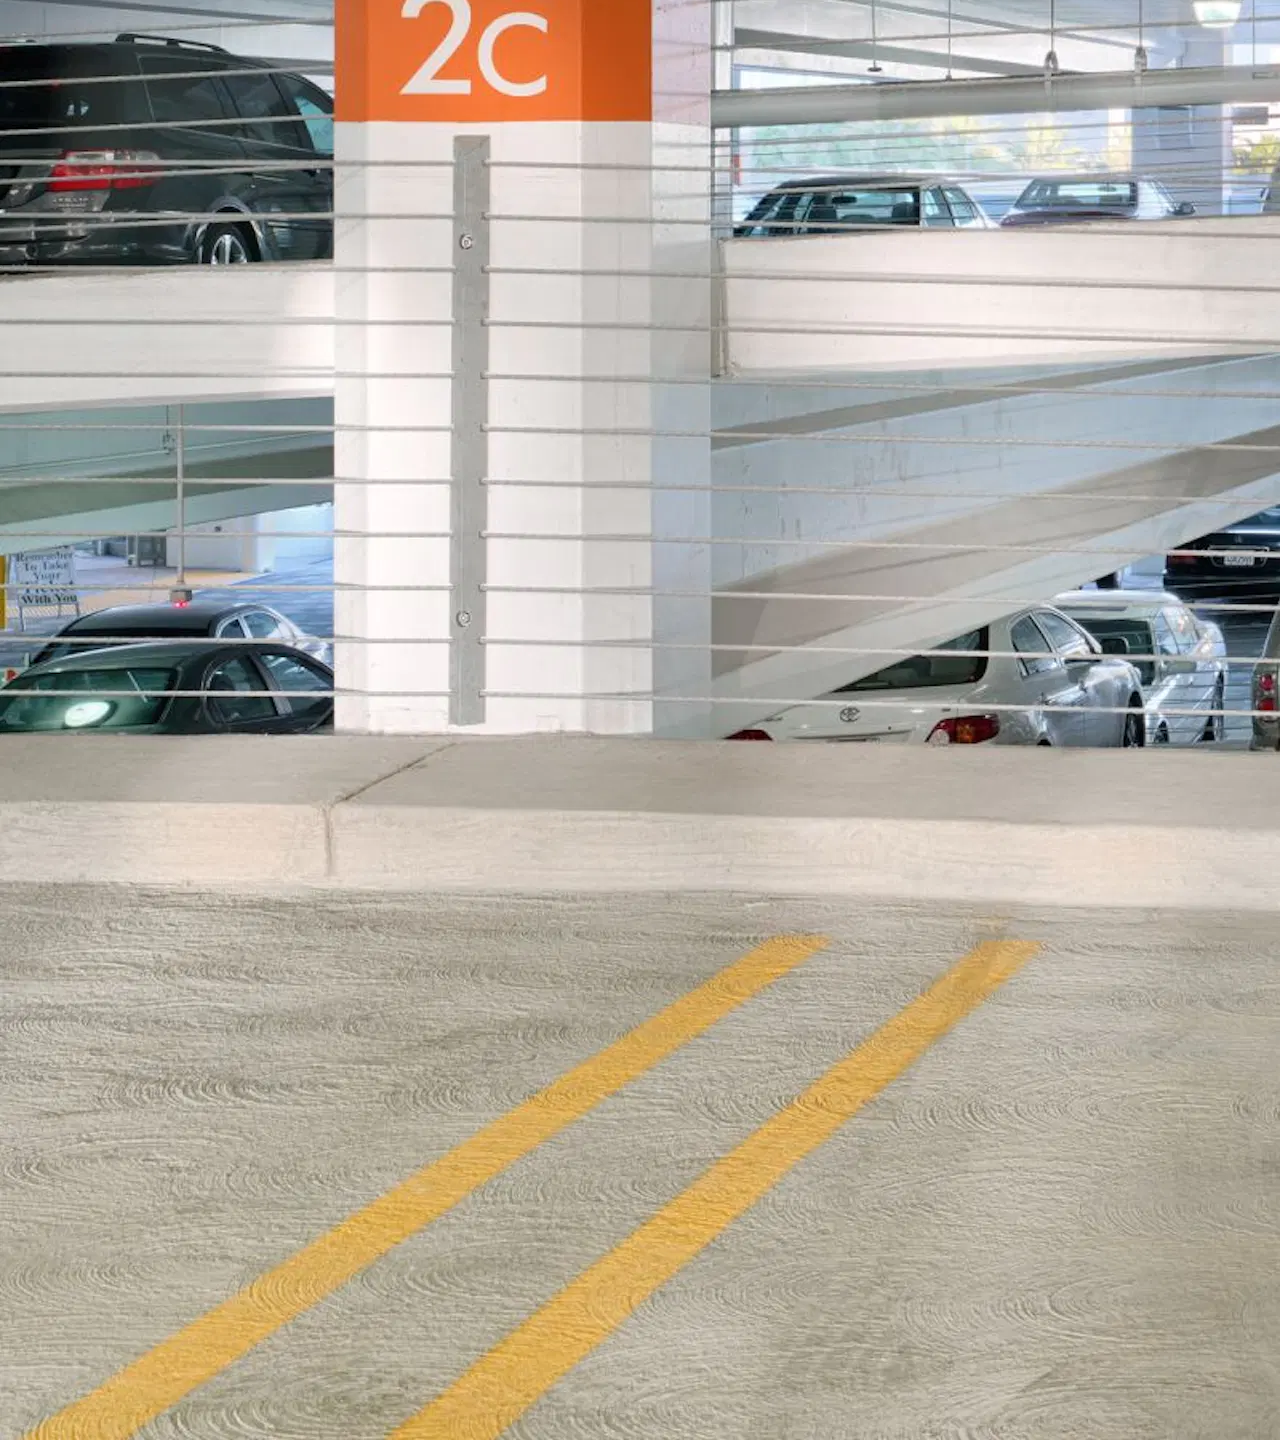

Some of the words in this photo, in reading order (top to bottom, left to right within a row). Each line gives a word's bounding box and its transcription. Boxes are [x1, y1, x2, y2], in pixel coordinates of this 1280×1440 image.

[24, 563, 38, 571] To
[43, 561, 68, 571] Take
[33, 571, 61, 580] Your
[21, 594, 51, 604] With
[54, 593, 78, 602] You
